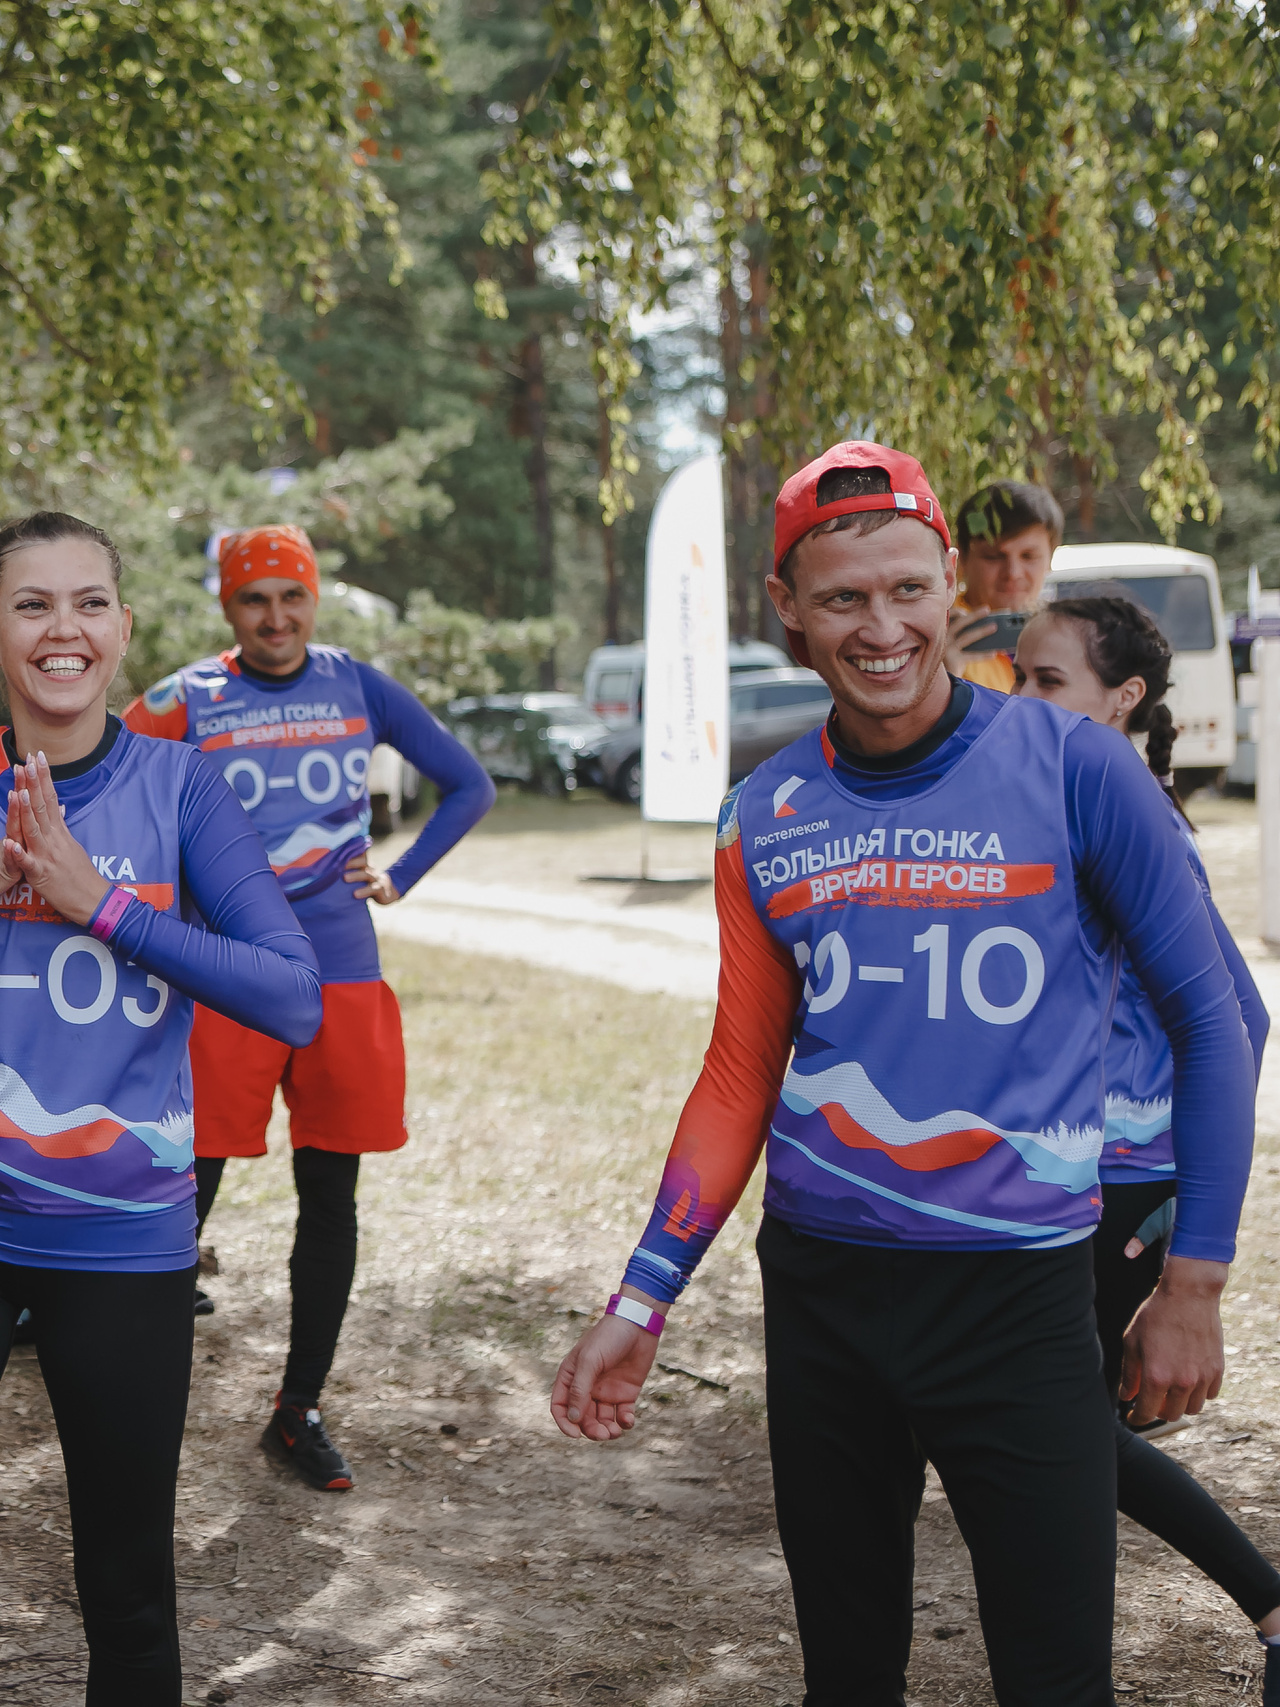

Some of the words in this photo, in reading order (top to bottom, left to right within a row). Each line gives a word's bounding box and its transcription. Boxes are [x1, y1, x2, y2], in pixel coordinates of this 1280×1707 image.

[195, 706, 282, 736] БОЛЬШАЯ
[283, 702, 343, 723] ГОНКА
[232, 724, 286, 746] ВРЕМЯ
[286, 719, 348, 739] ГЕРОЕВ
[222, 747, 370, 812] 0-09
[753, 819, 830, 850] Ростелеком
[752, 828, 885, 888] БОЛЬШАЯ
[894, 828, 1005, 861] ГОНКА
[894, 863, 1007, 894] ГЕРОЕВ
[793, 923, 1045, 1025] 0-10
